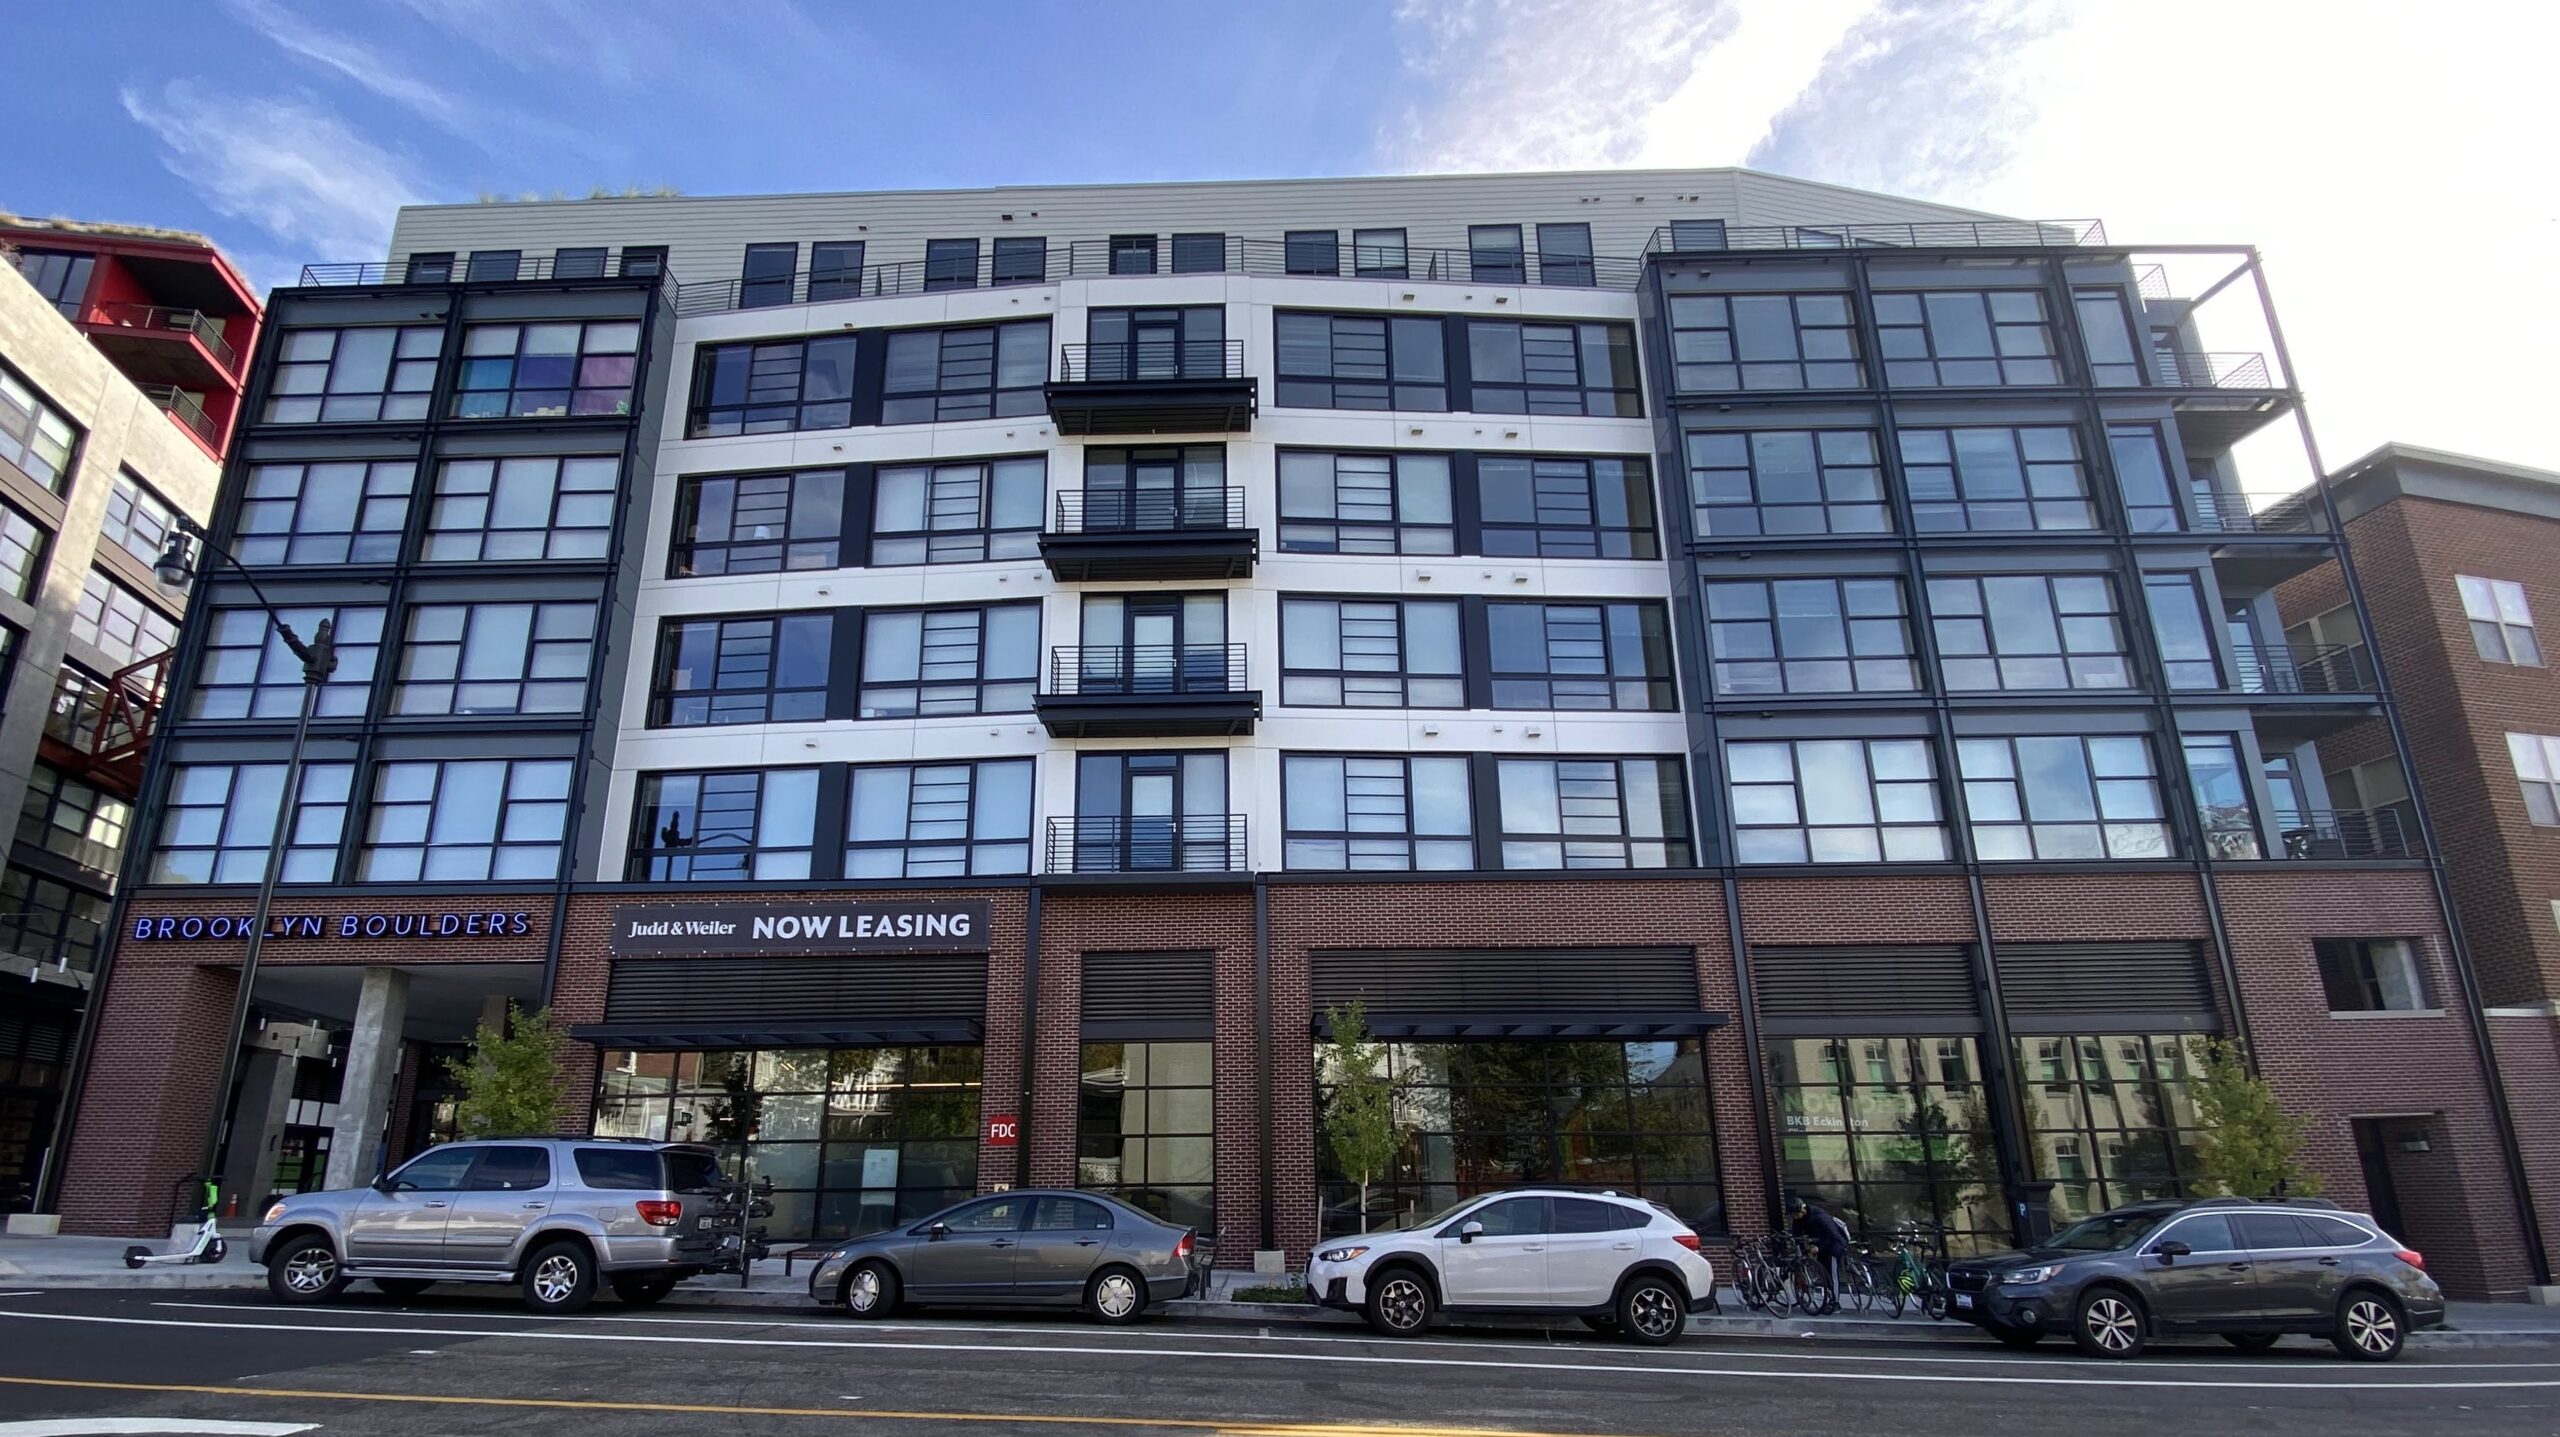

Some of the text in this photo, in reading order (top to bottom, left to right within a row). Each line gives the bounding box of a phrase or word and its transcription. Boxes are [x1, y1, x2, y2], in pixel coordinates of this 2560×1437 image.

[340, 911, 529, 938] BOULDERS
[629, 914, 971, 940] Judd & Weiler NOW LEASING
[990, 1123, 1016, 1138] FDC
[1786, 1115, 1868, 1127] BKB Eckinton
